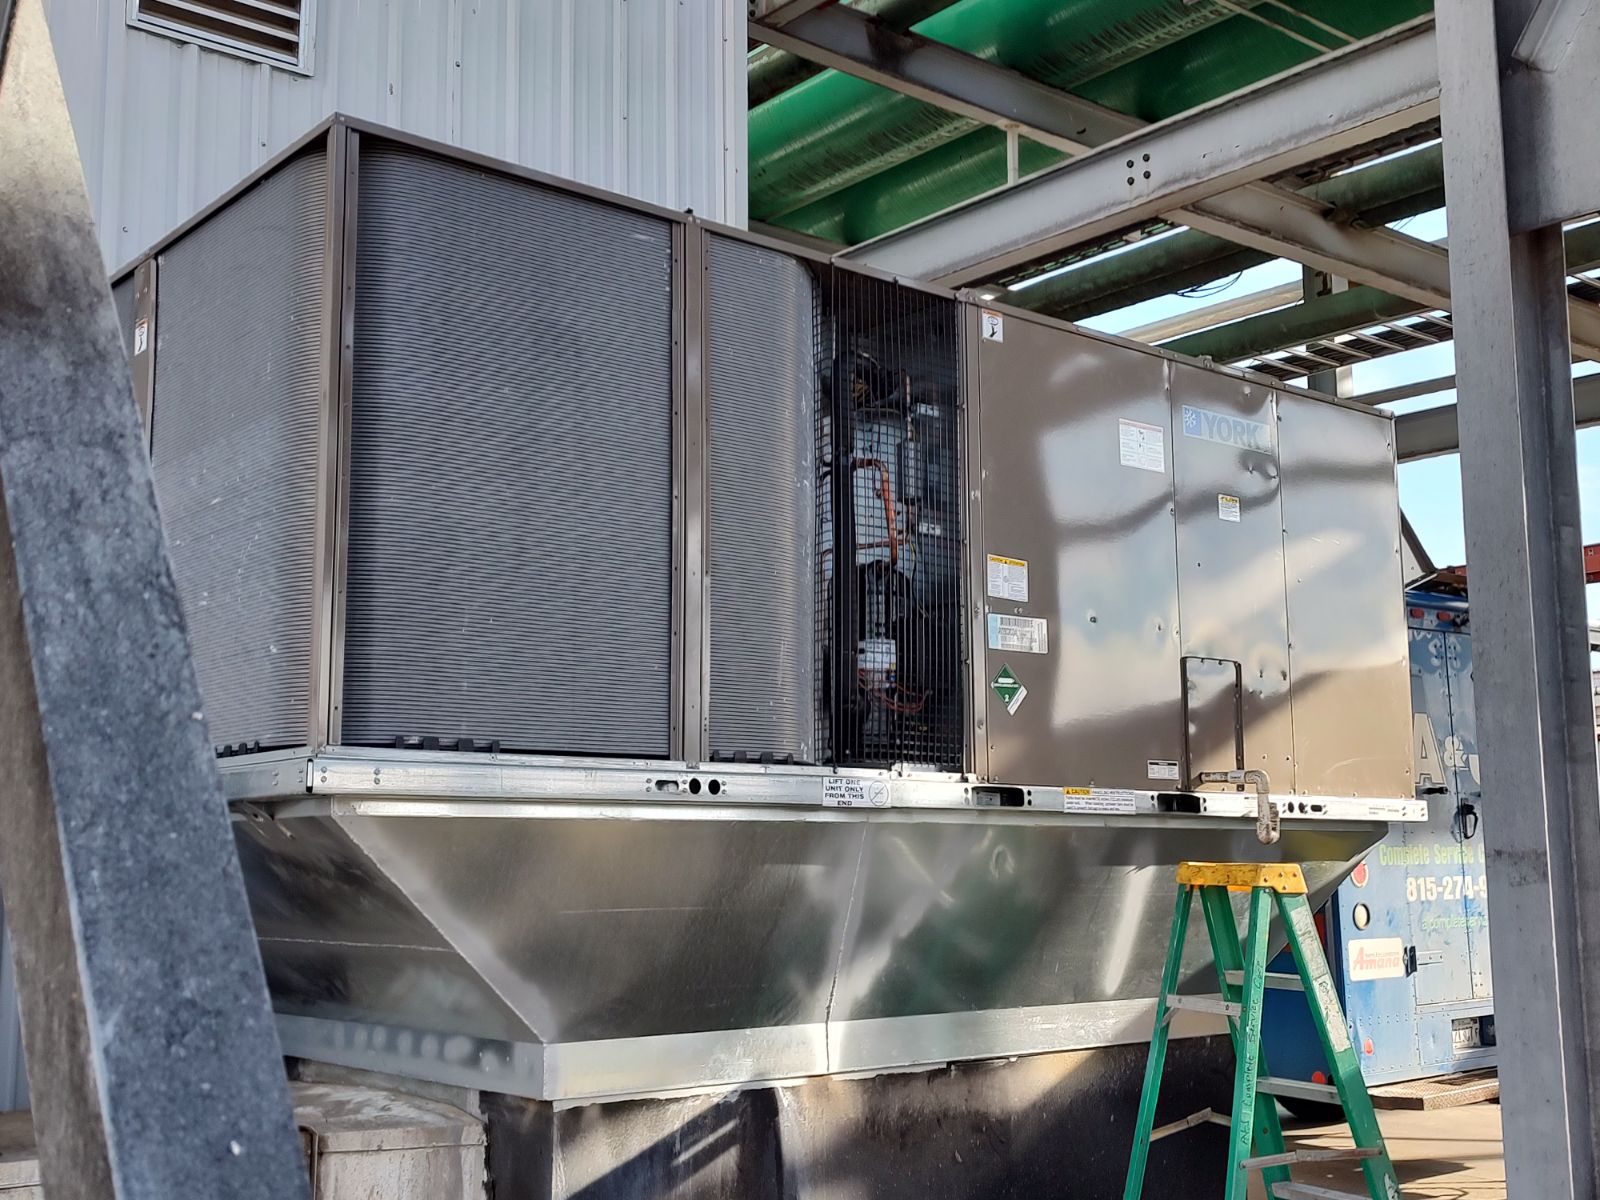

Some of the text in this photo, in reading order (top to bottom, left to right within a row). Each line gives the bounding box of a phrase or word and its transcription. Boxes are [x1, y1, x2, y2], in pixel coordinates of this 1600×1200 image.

[1203, 412, 1259, 449] YORK
[1004, 694, 1010, 702] 2
[1379, 844, 1429, 866] Complete
[1434, 843, 1474, 864] Service
[1353, 946, 1401, 971] Amana
[1247, 997, 1260, 1044] Service
